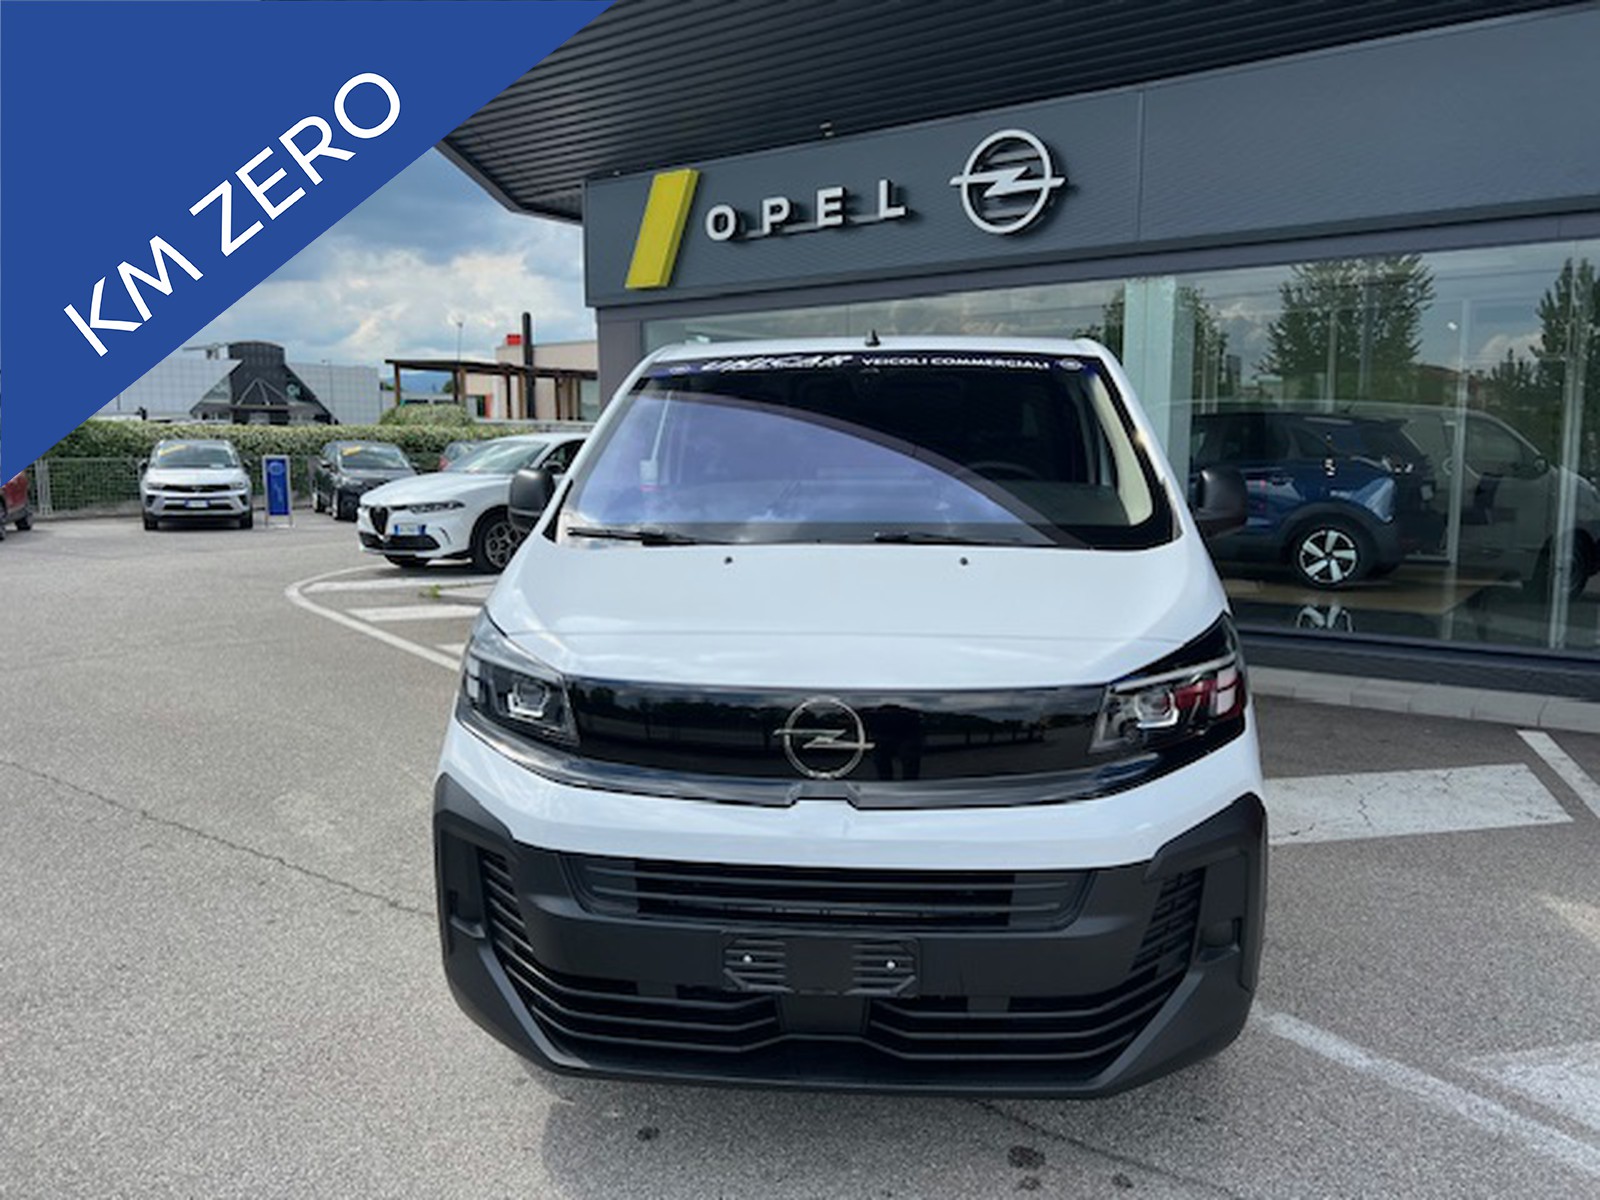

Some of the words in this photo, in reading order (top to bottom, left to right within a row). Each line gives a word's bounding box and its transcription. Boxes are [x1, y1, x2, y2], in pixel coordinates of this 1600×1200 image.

[705, 179, 906, 242] OPEL
[861, 356, 927, 366] VEICOLI
[931, 356, 1050, 369] COMMERCIALI
